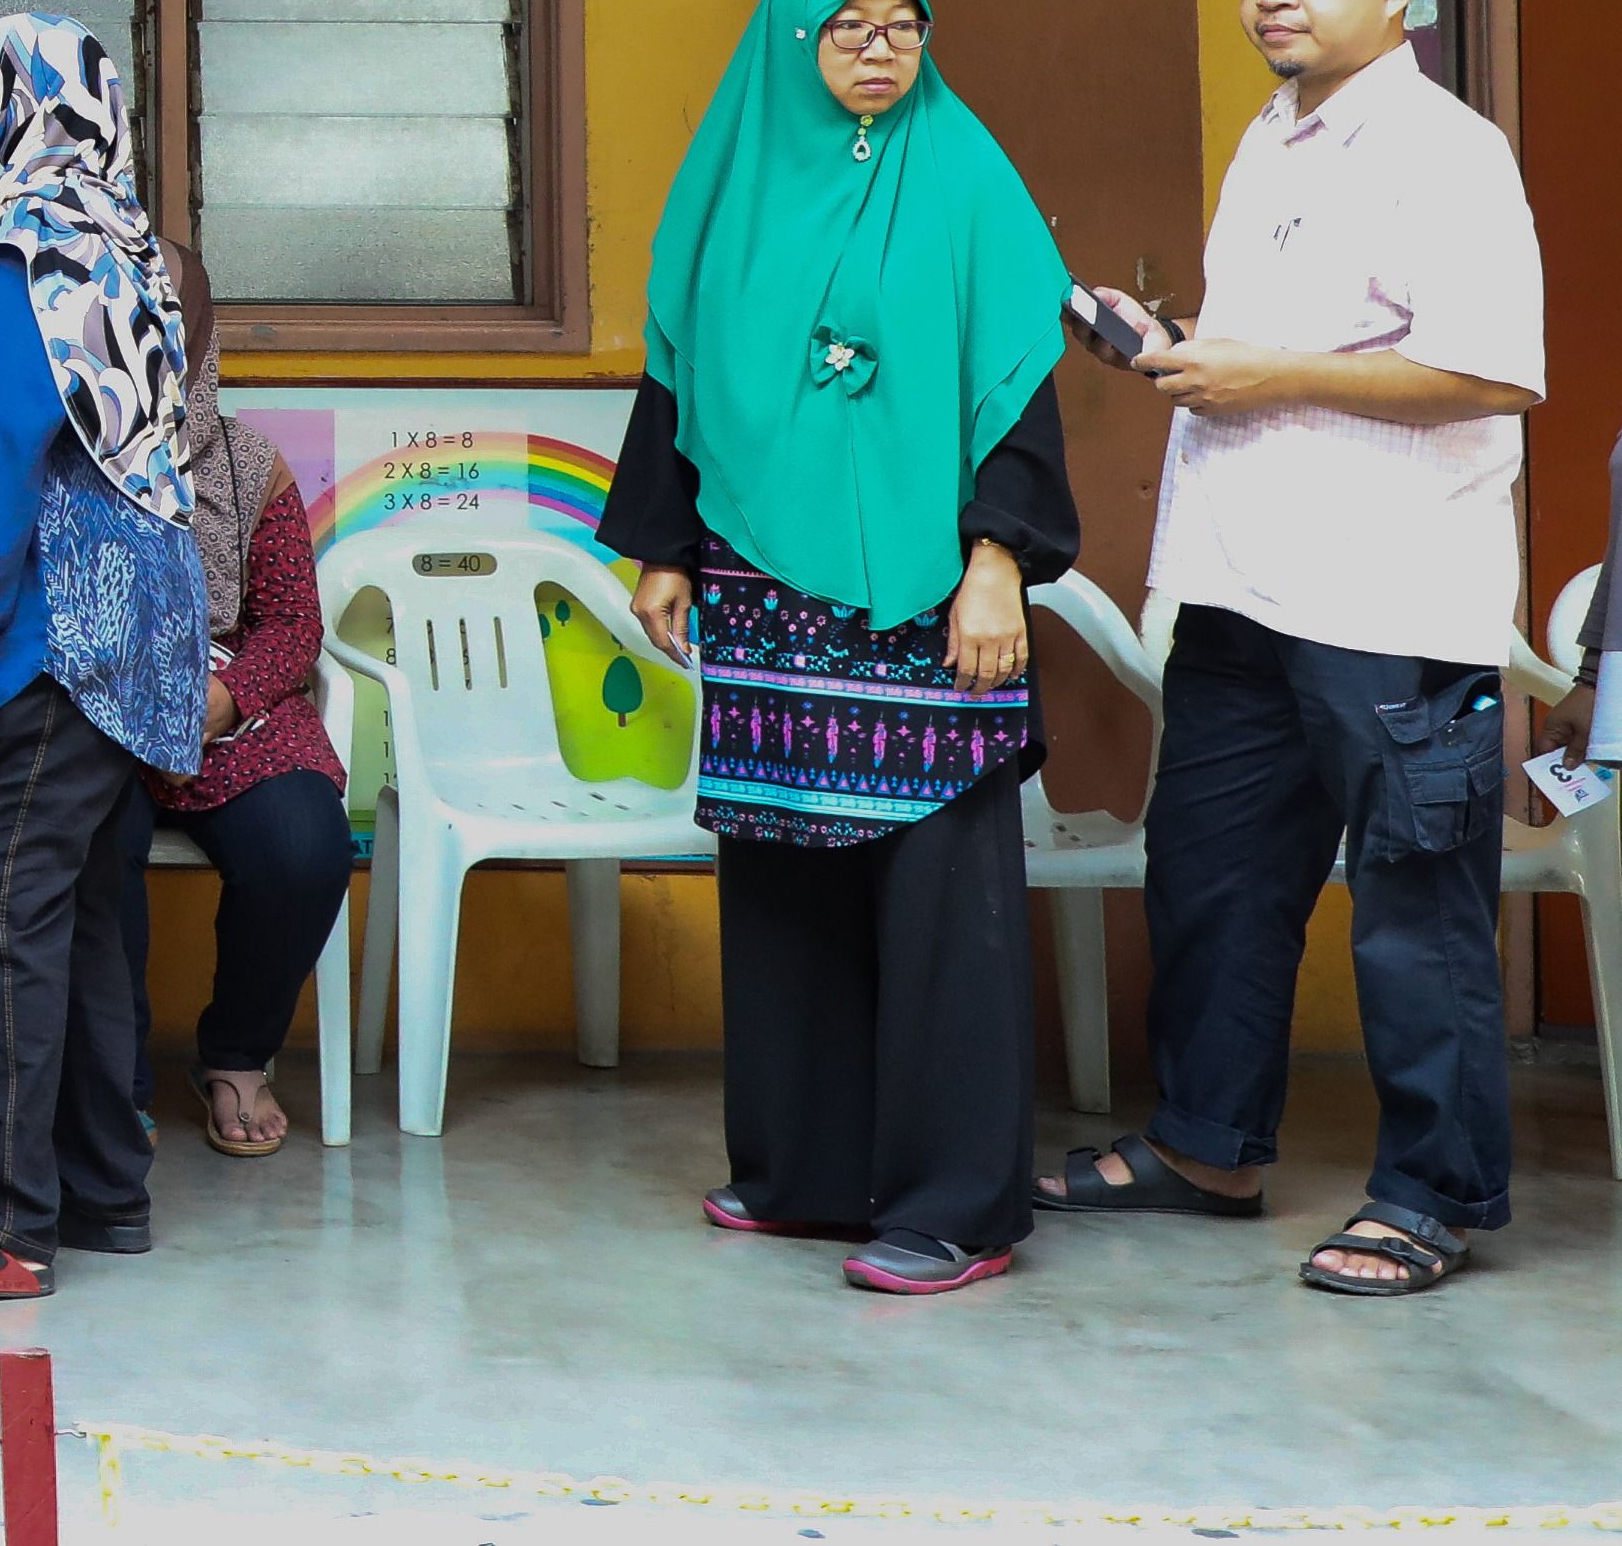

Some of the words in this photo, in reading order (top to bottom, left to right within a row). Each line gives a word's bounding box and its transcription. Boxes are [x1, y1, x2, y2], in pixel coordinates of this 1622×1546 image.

[392, 431, 397, 448] 1
[408, 431, 419, 448] X
[426, 431, 437, 448] 8
[462, 431, 473, 448] 8
[384, 462, 395, 479] 2
[402, 462, 413, 479] X
[420, 462, 431, 479] 8
[458, 462, 479, 479] 16
[384, 493, 395, 510] 3
[402, 493, 414, 510] X
[420, 493, 432, 510] 8
[457, 493, 479, 510] 24
[421, 555, 432, 572] 8
[458, 555, 481, 572] 40
